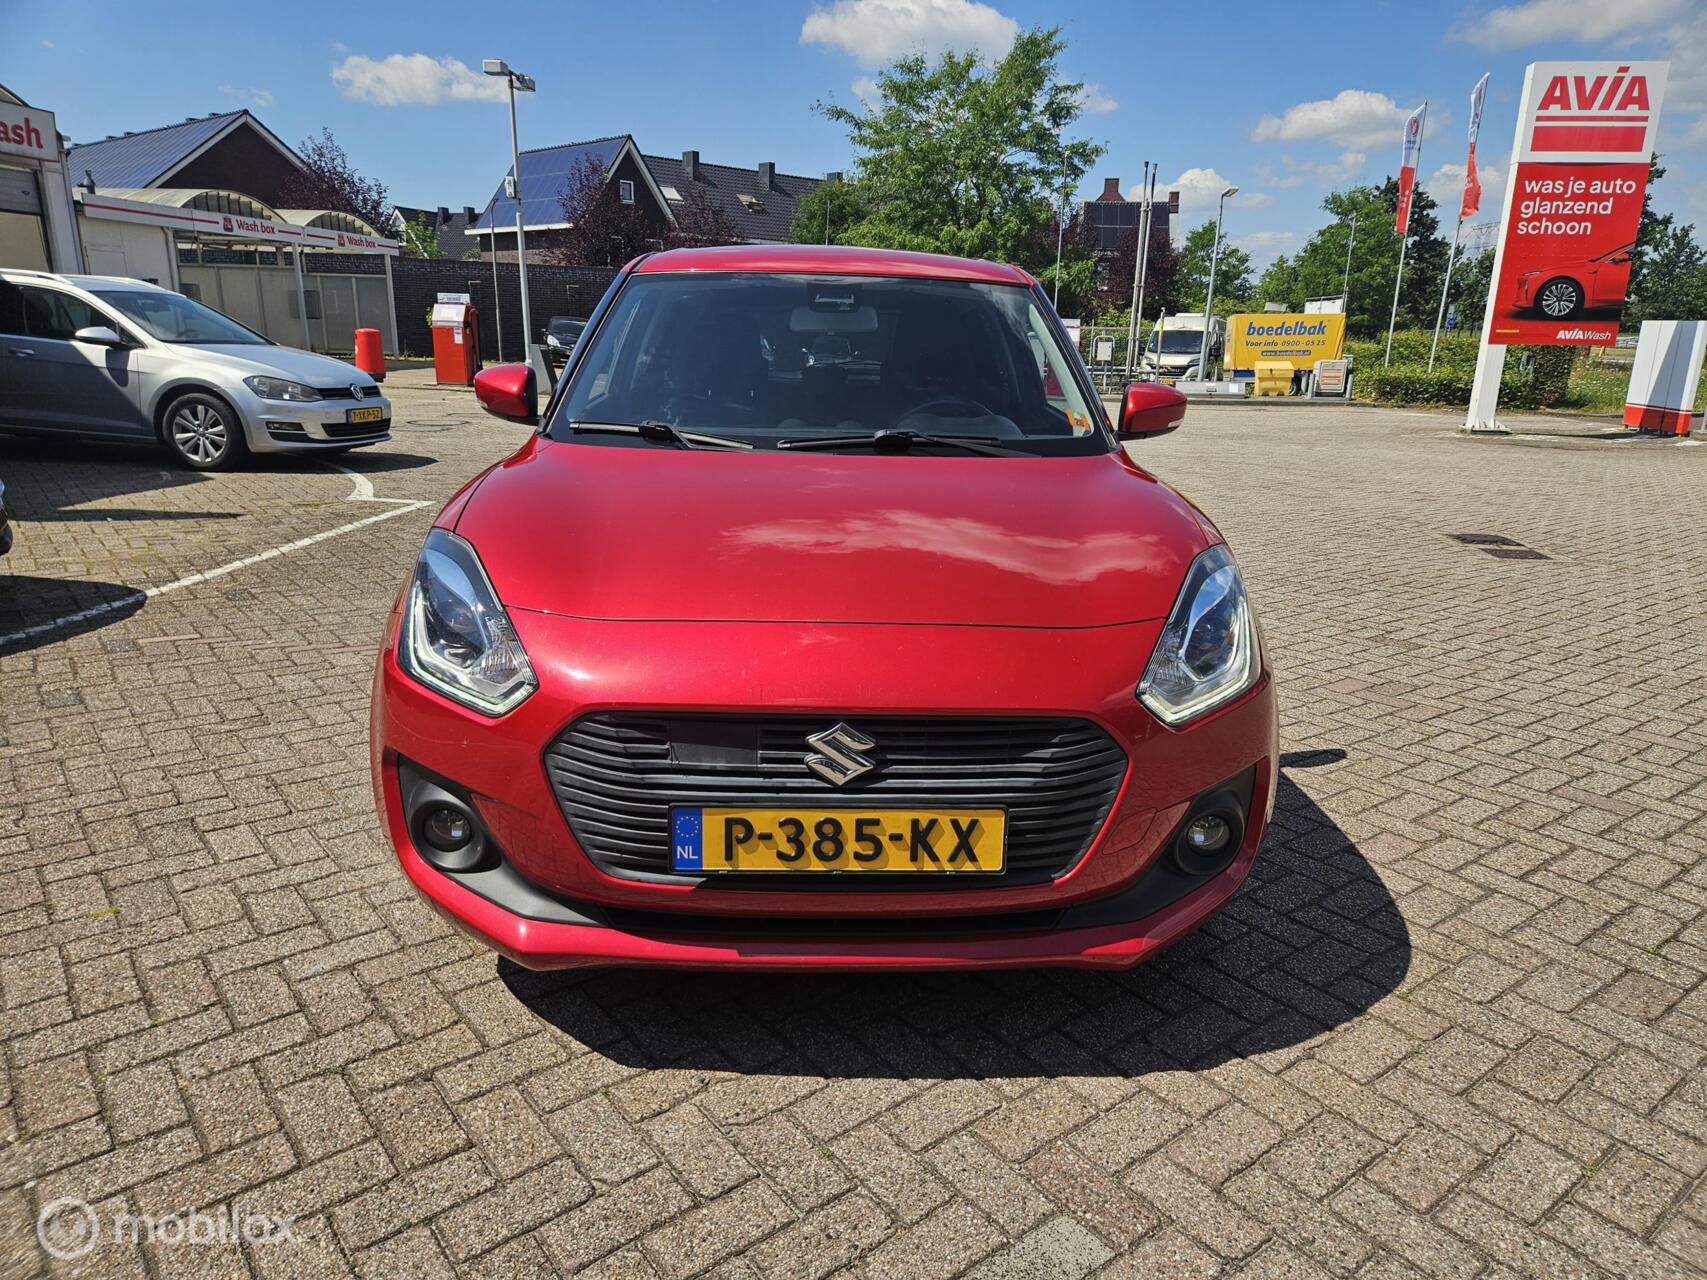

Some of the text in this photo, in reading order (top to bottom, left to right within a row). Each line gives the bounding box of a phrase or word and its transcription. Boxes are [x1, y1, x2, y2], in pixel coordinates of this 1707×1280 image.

[1524, 176, 1636, 198] was je auto
[1520, 197, 1613, 218] glanzend
[236, 218, 276, 234] Wash box
[1517, 217, 1592, 235] schoon
[347, 234, 376, 249] Wash box
[1246, 320, 1327, 336] boedelbak
[1263, 339, 1279, 347] info
[1281, 339, 1300, 347] 0900
[724, 817, 980, 863] P-385-KX
[676, 845, 698, 860] NL
